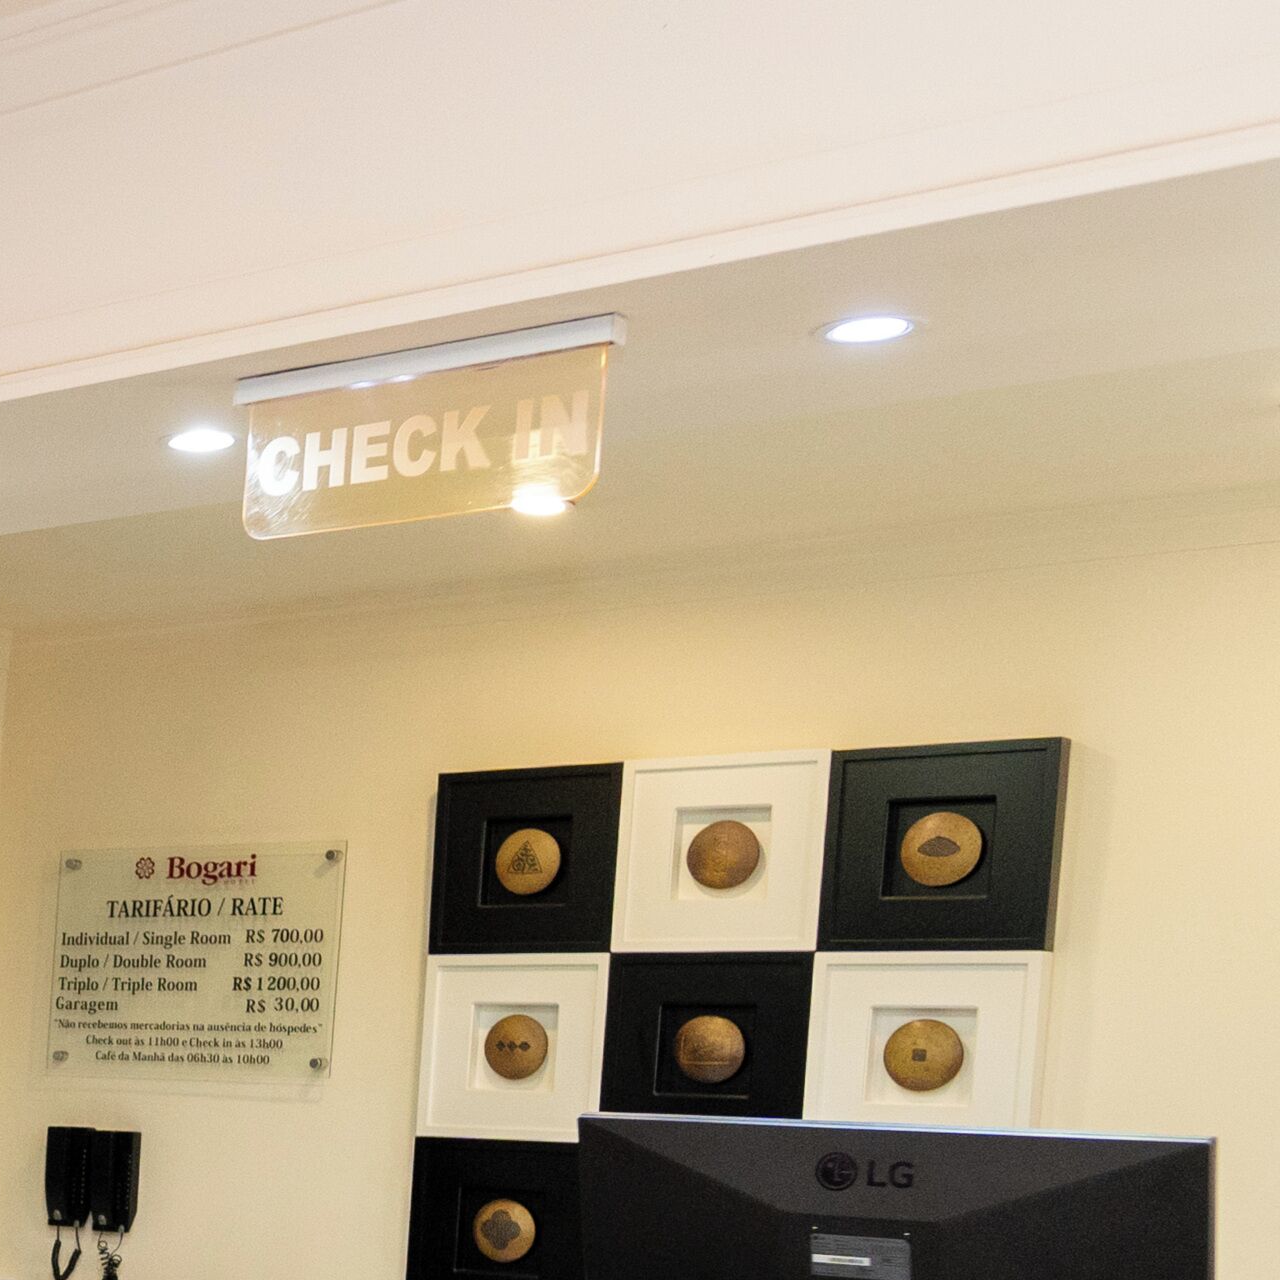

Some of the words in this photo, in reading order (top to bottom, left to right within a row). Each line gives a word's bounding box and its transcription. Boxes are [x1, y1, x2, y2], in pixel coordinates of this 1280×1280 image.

[258, 404, 493, 498] CHECK
[514, 389, 591, 463] IN
[166, 853, 257, 886] Bogari
[106, 894, 212, 919] TARIFÁRIO
[231, 896, 284, 917] RATE
[61, 931, 130, 946] Individual
[142, 930, 186, 949] Single
[190, 930, 231, 945] Room
[245, 928, 266, 944] R$
[271, 928, 324, 945] 700,00
[60, 953, 100, 972] Duplo
[113, 953, 161, 969] Double
[165, 953, 207, 969] Room
[243, 951, 264, 968] R$
[268, 951, 322, 969] 900,00
[58, 976, 100, 995] Triplo
[111, 976, 153, 995] Triple
[157, 976, 198, 992] Room
[231, 976, 252, 992] R$
[55, 996, 119, 1015] Garagem
[245, 998, 267, 1014] R$
[273, 996, 320, 1013] 30,00
[78, 1019, 128, 1030] recebemos
[130, 1020, 190, 1031] mercadorias
[193, 1023, 205, 1032] na
[207, 1022, 251, 1032] ausência
[254, 1022, 267, 1033] de
[86, 1034, 114, 1046] Check
[116, 1036, 132, 1046] out
[148, 1036, 180, 1047] 11h00
[190, 1037, 220, 1049] Check
[222, 1037, 233, 1048] in
[250, 1039, 284, 1050] 13h00
[95, 1050, 116, 1061] Café
[118, 1050, 130, 1061] da
[132, 1051, 166, 1063] Manhã
[168, 1051, 185, 1063] das
[186, 1052, 220, 1064] 06h30
[236, 1054, 271, 1065] 10h00
[865, 1160, 915, 1189] LG
